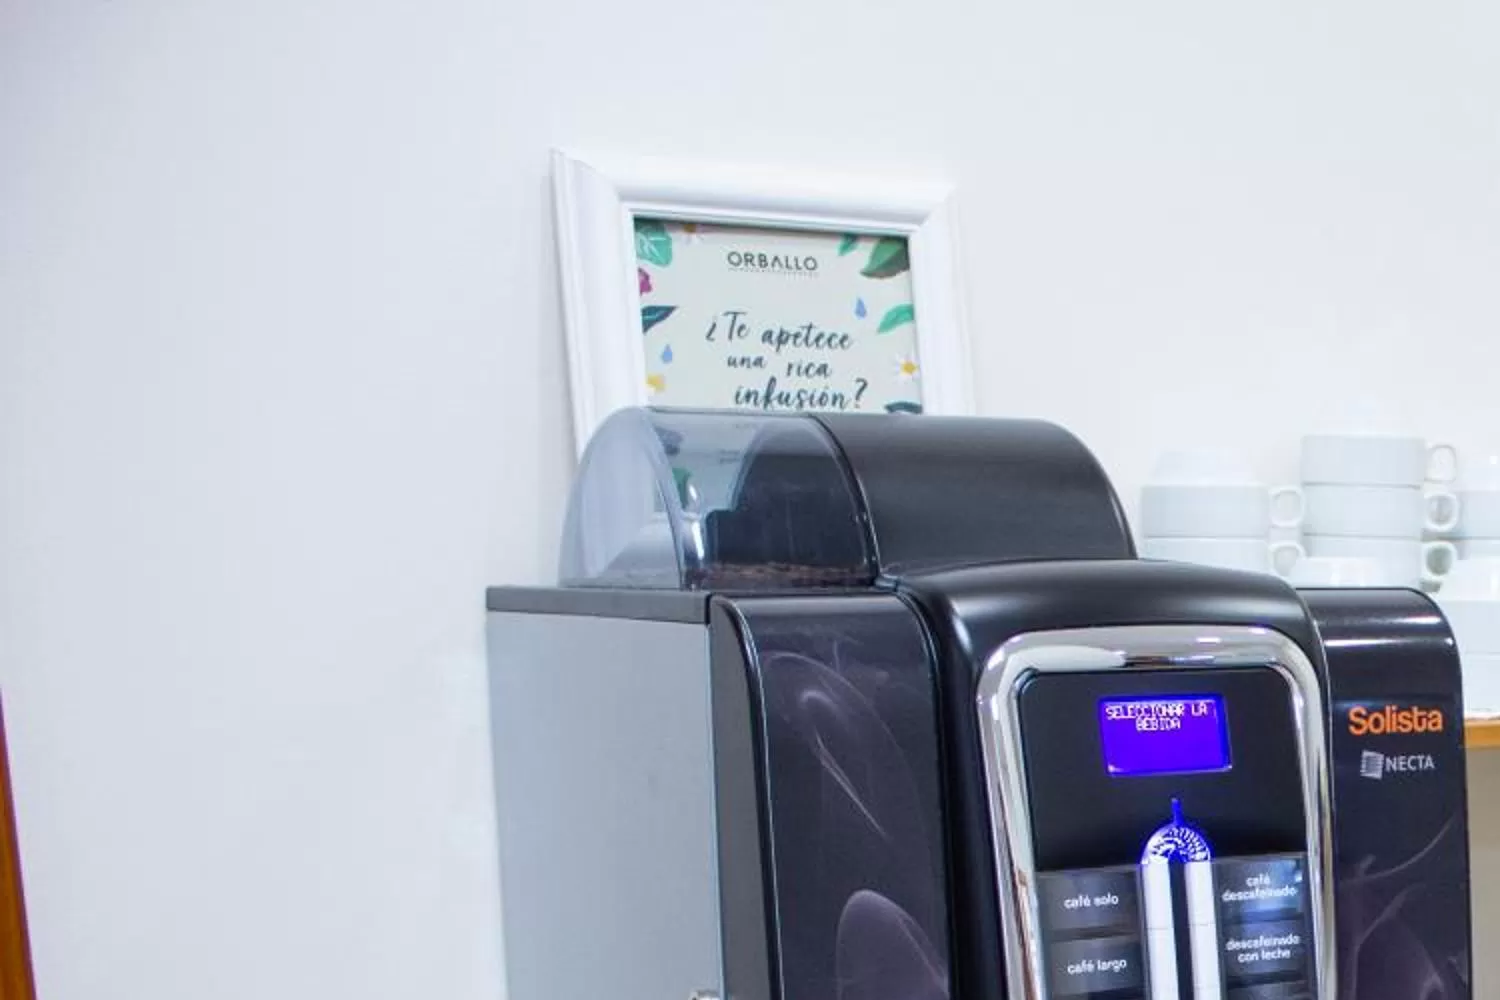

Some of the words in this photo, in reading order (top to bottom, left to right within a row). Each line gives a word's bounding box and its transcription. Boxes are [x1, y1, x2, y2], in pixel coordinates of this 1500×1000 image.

[727, 251, 818, 271] ORBALLO
[705, 311, 750, 342] ¿Te
[761, 322, 853, 353] apetece
[727, 354, 767, 370] una
[786, 357, 832, 378] rica
[1191, 701, 1208, 716] LA
[1348, 706, 1444, 736] Solista
[1385, 754, 1435, 773] NECTA
[1246, 872, 1271, 887] café
[1064, 893, 1091, 909] café
[1094, 893, 1119, 907] solo
[1237, 951, 1259, 963] con
[1261, 947, 1292, 960] leche
[1067, 960, 1095, 975] café
[1097, 957, 1128, 973] largo
